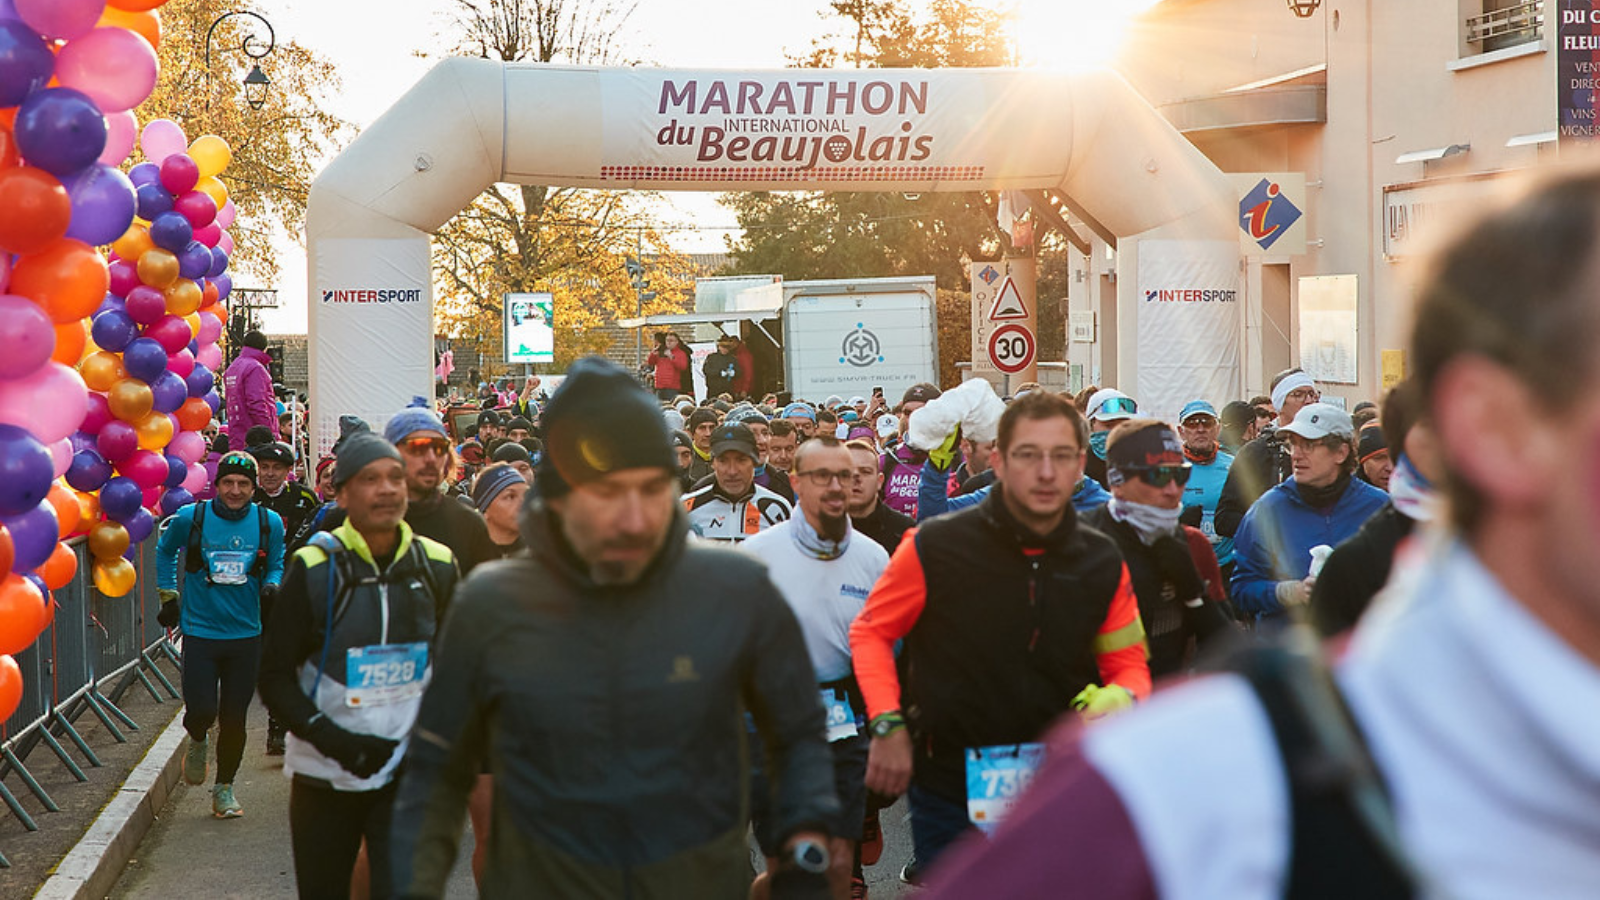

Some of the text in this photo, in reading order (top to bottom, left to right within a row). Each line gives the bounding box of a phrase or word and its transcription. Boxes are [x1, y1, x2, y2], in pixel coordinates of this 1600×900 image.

[1563, 10, 1585, 24] DU
[1564, 35, 1600, 50] FLEU
[658, 80, 928, 115] MARATHON
[1571, 108, 1597, 119] VINS
[724, 119, 850, 133] INTERNATIONAL
[657, 120, 933, 171] du Beaujolais
[334, 290, 421, 303] INTERSPORT
[1159, 290, 1236, 302] INTERSPORT
[998, 337, 1026, 360] 30
[890, 474, 920, 487] MAR
[358, 660, 416, 687] 7528
